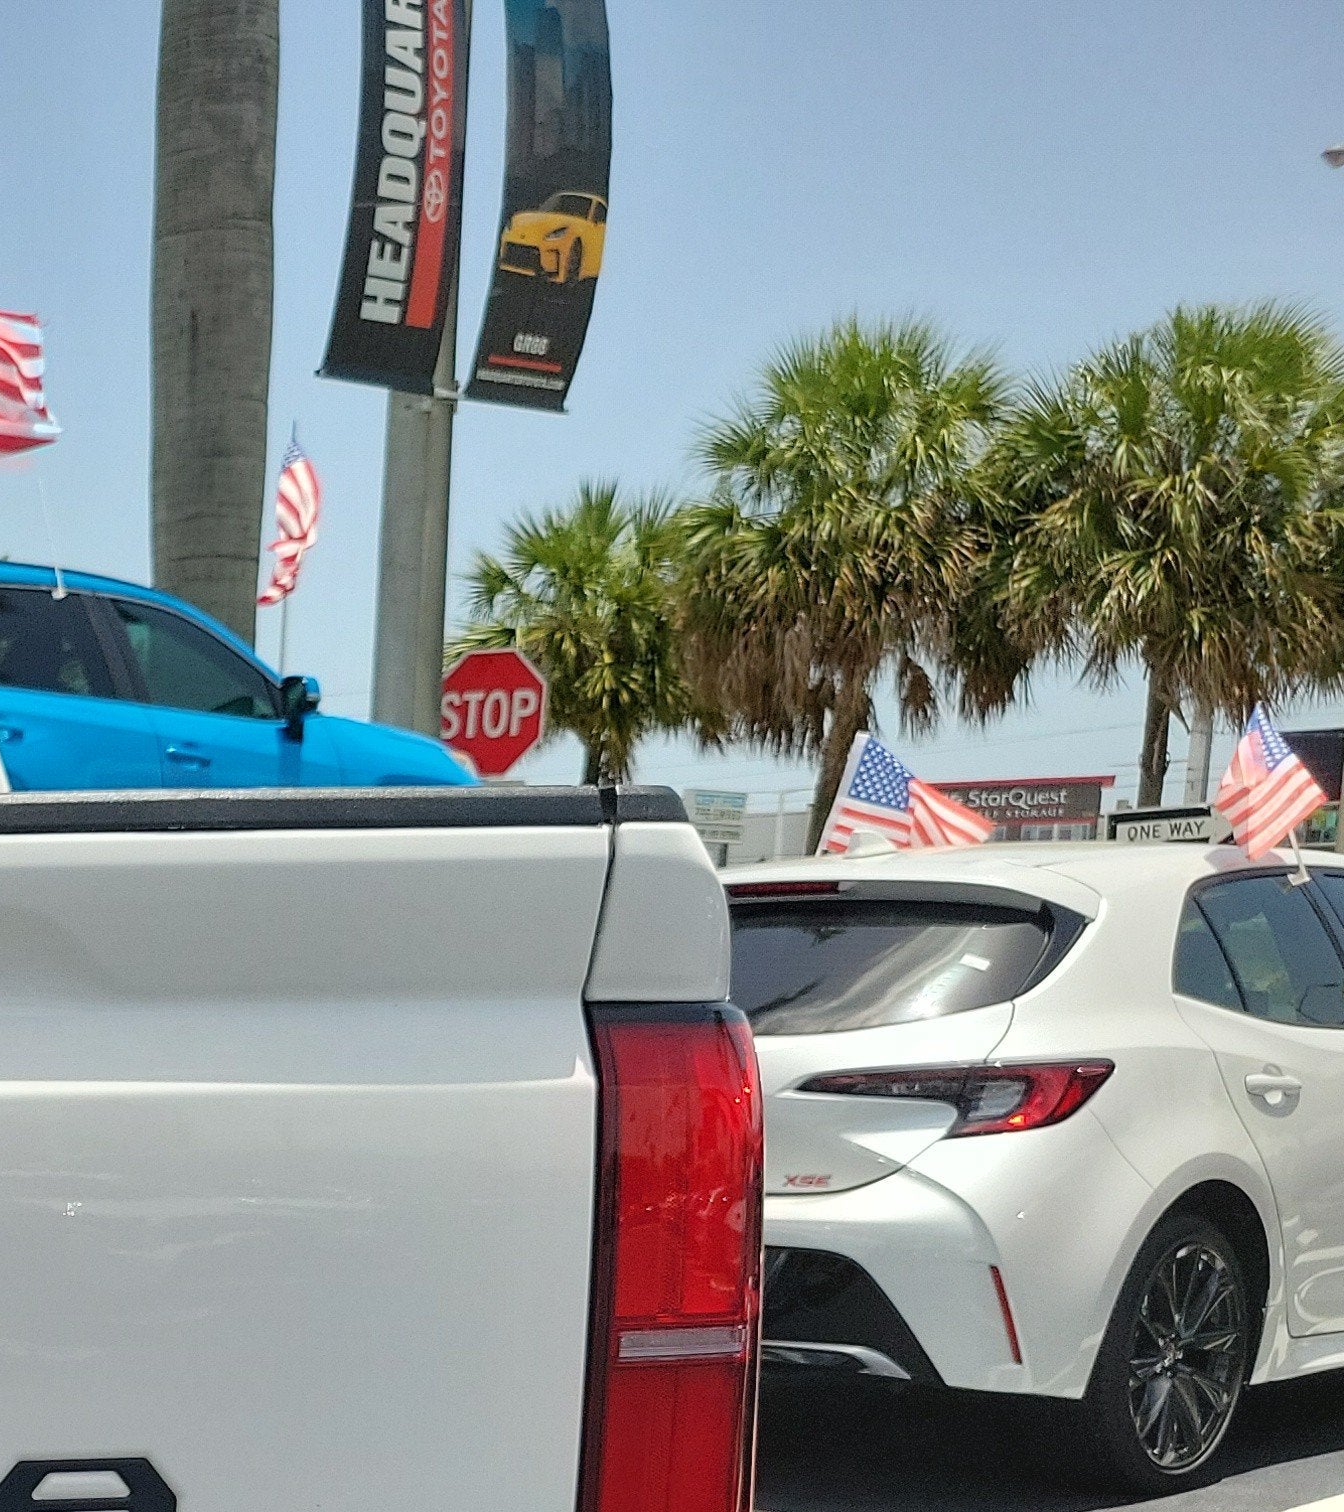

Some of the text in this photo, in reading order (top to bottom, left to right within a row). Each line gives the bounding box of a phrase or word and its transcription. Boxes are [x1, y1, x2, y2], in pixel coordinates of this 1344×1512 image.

[429, 0, 449, 162] TOYOTA
[440, 688, 538, 739] STOP
[968, 788, 1067, 810] StorQuest
[1127, 820, 1204, 841] ONE WAY
[783, 1174, 830, 1188] XSE
